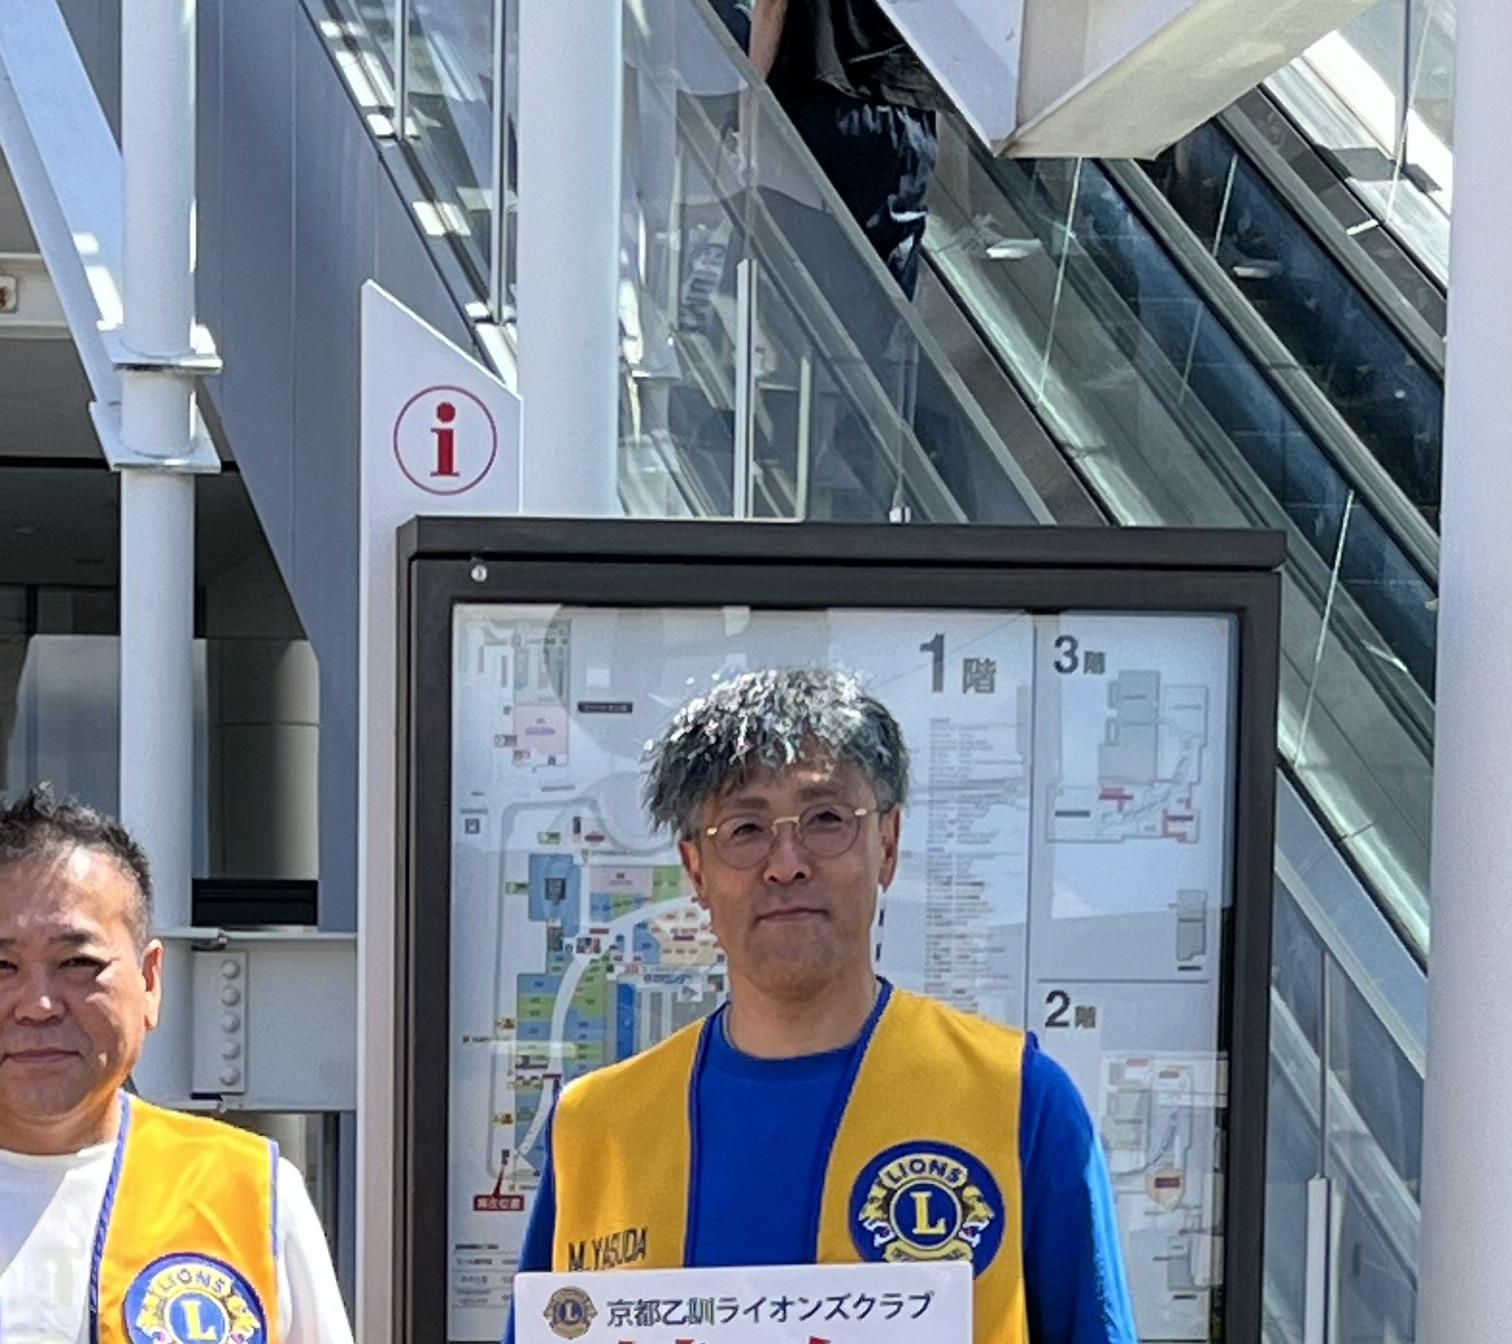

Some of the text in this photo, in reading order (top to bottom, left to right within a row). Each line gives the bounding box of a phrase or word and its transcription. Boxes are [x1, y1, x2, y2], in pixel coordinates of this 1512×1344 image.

[919, 633, 996, 693] 1階
[1054, 635, 1106, 675] 3階
[1045, 990, 1096, 1029] 2階
[887, 1158, 961, 1184] LIONS
[910, 1191, 946, 1235] L
[157, 1267, 225, 1292] LIONS
[181, 1299, 217, 1340] L
[606, 1290, 934, 1327] 京都乙訓ライオンズクラブ
